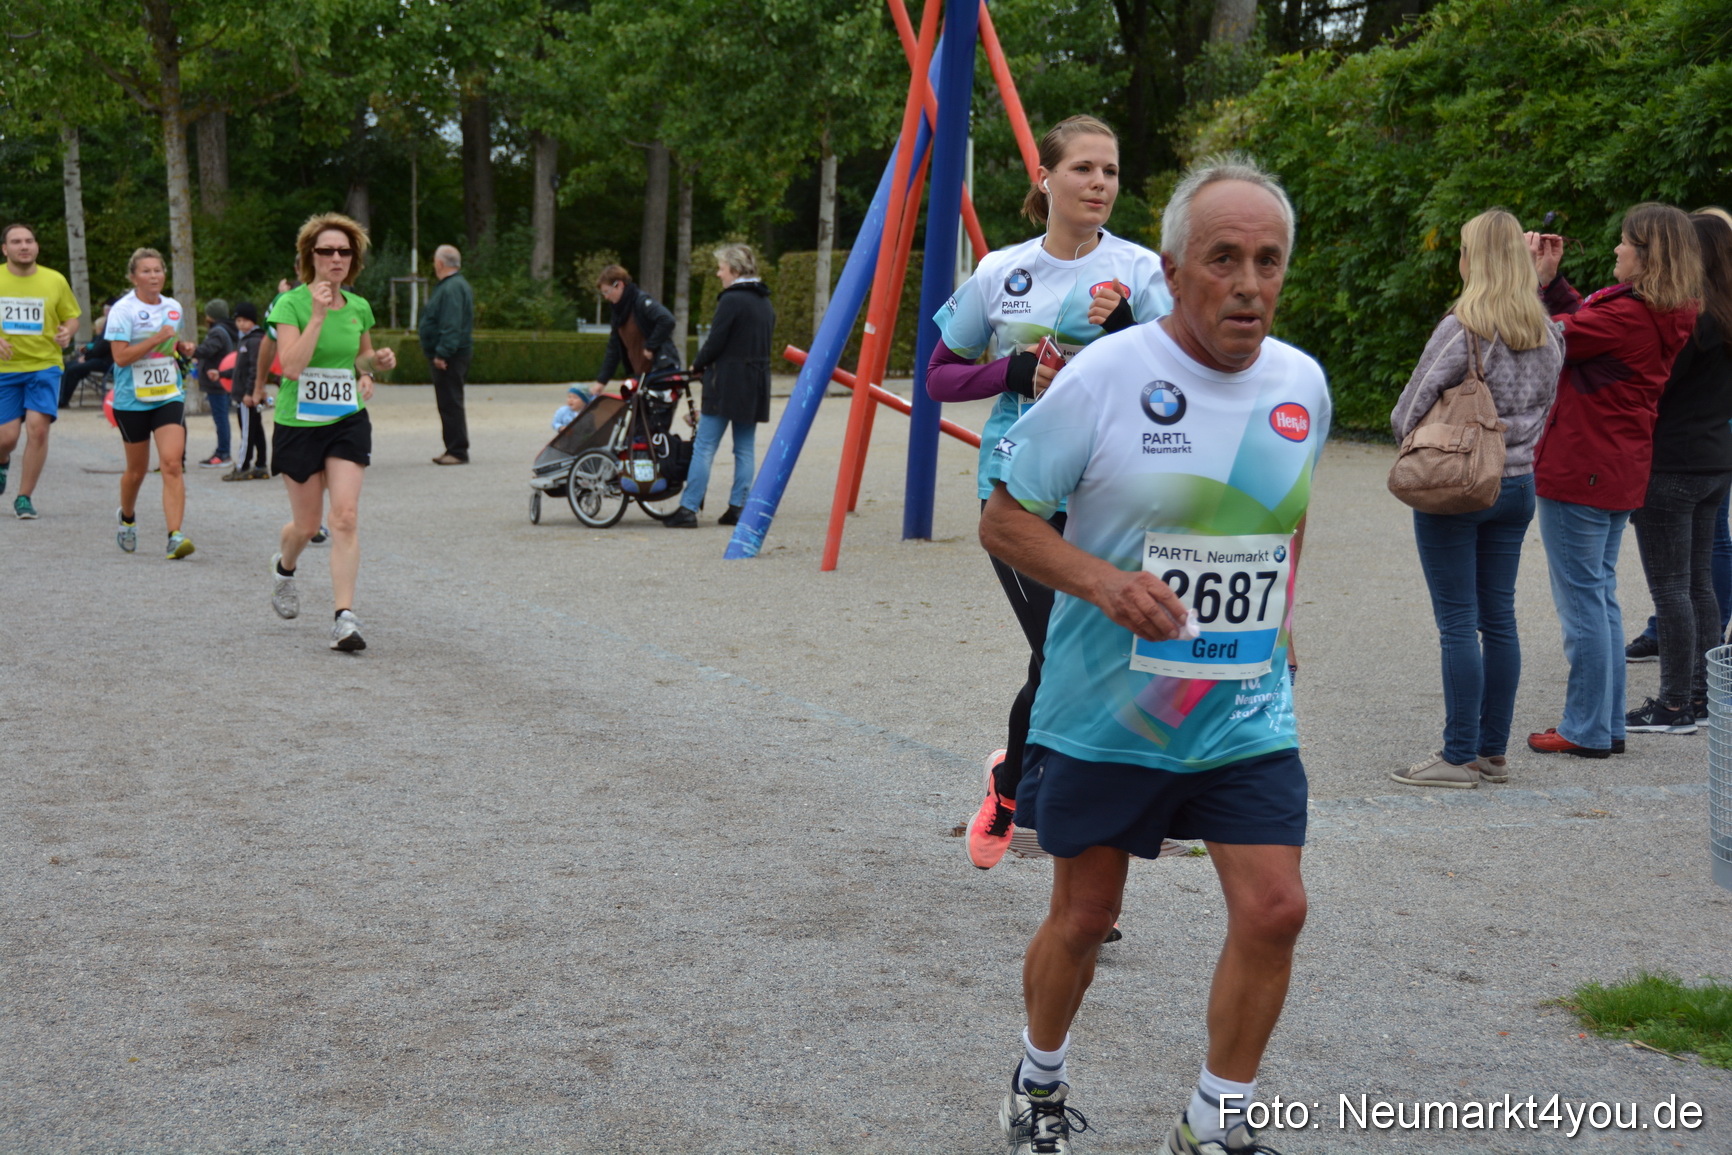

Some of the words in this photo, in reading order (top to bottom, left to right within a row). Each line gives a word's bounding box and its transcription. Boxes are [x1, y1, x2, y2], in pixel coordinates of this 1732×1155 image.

[1002, 301, 1031, 309] PARTL
[5, 306, 40, 321] 2110
[143, 368, 171, 385] 202
[305, 381, 352, 402] 3048
[1142, 433, 1191, 445] PARTL
[1142, 445, 1192, 454] Neumarkt
[1149, 545, 1202, 562] PARTL
[1207, 550, 1269, 563] Neumarkt
[1192, 638, 1238, 659] Gerd
